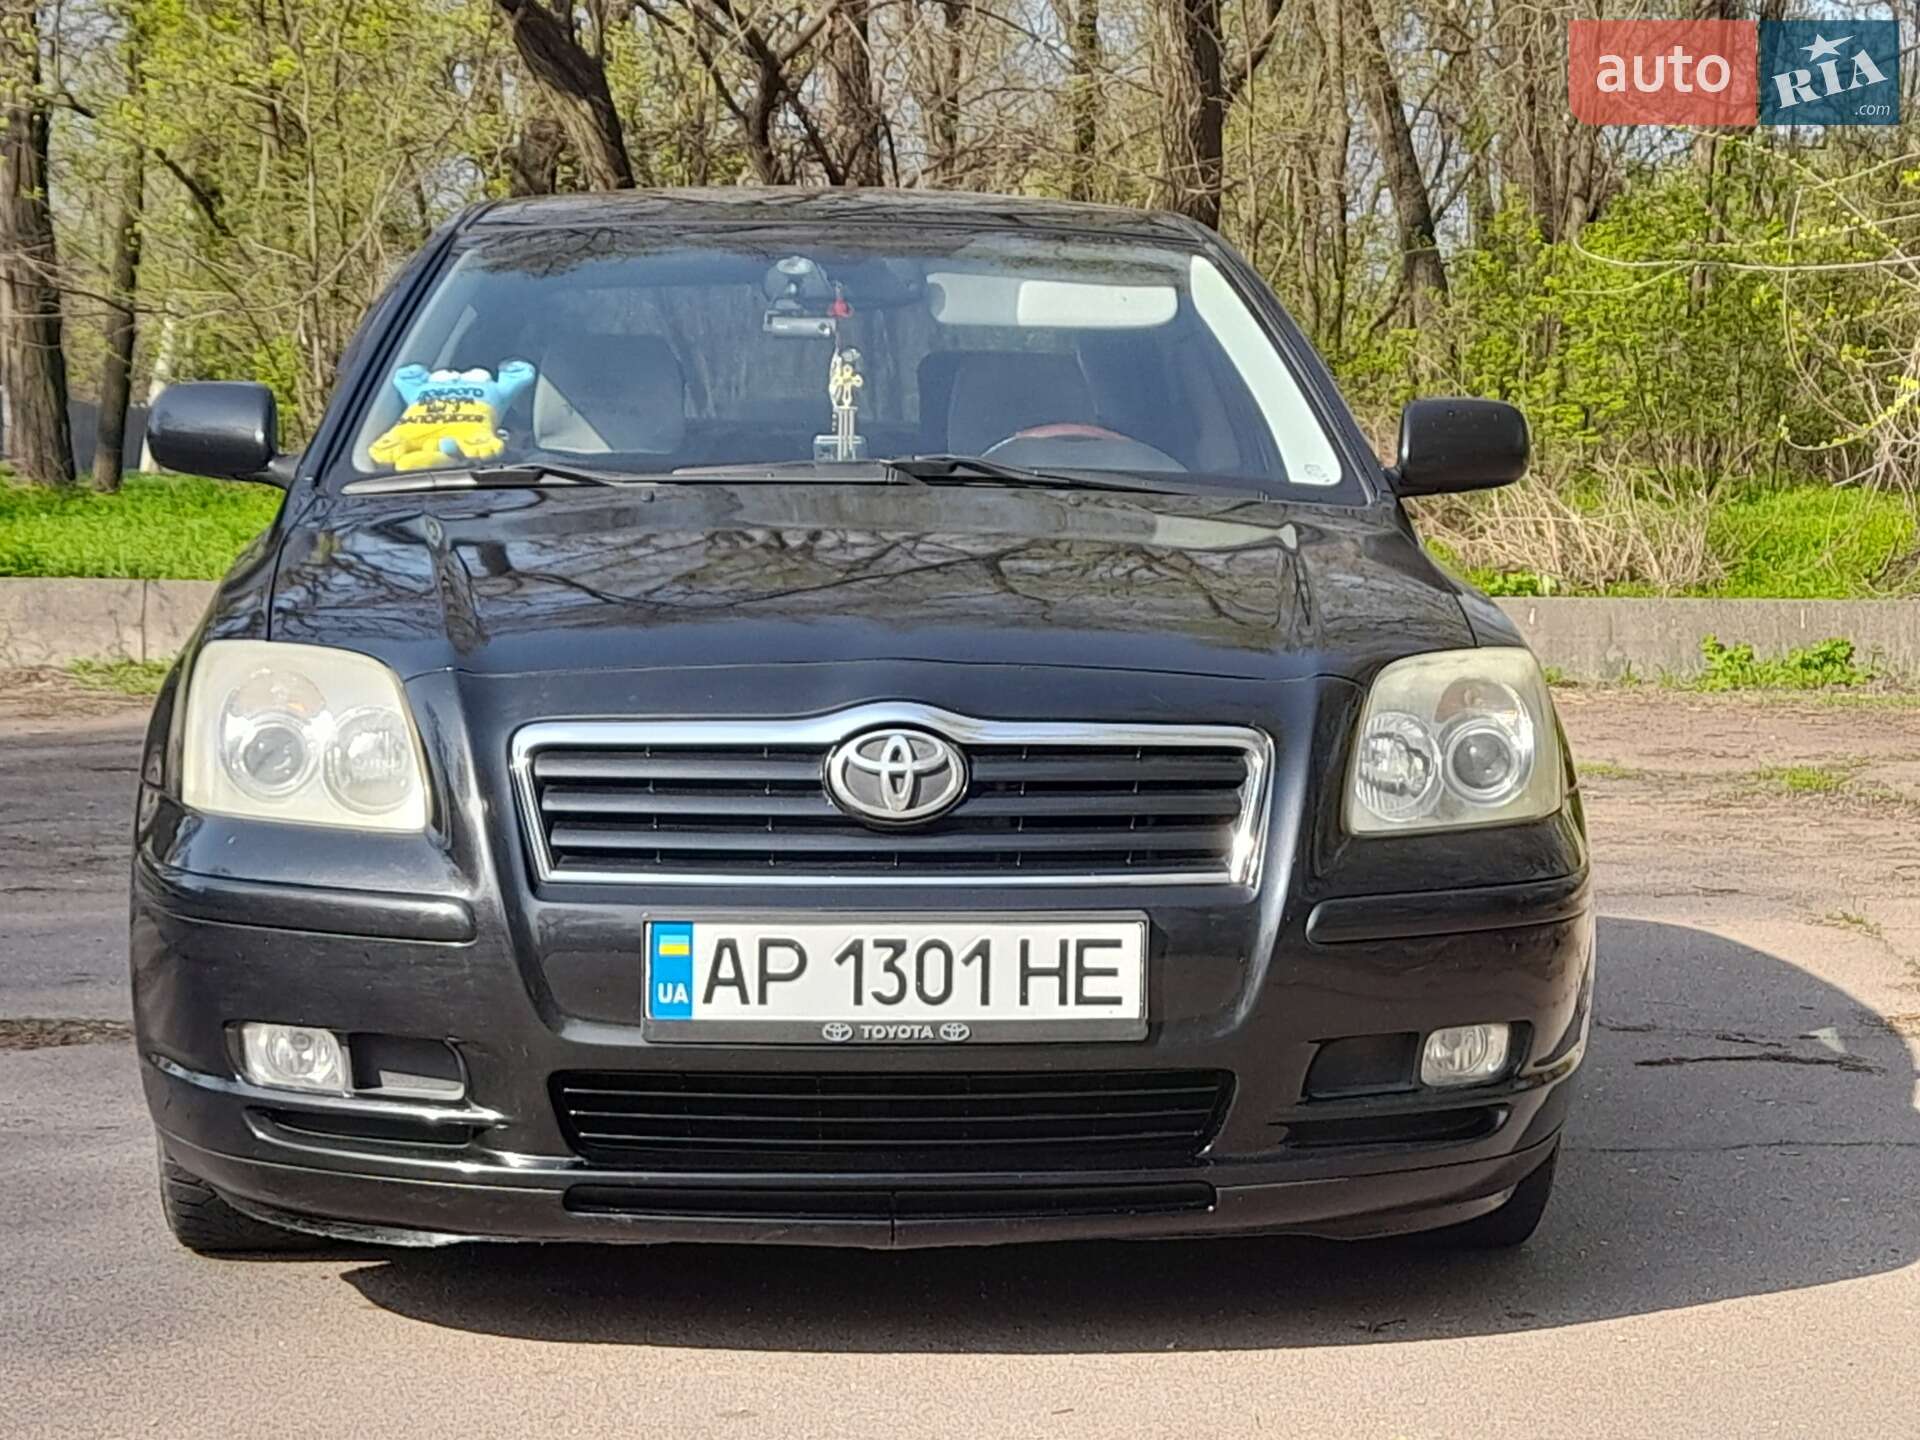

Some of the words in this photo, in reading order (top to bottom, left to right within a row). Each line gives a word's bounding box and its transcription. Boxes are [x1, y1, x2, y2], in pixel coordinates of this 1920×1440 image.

[702, 938, 808, 1006] AP
[834, 938, 991, 1007] 1301
[1018, 938, 1124, 1007] HE
[658, 982, 689, 1004] UA
[860, 1024, 934, 1039] TOYOTA
